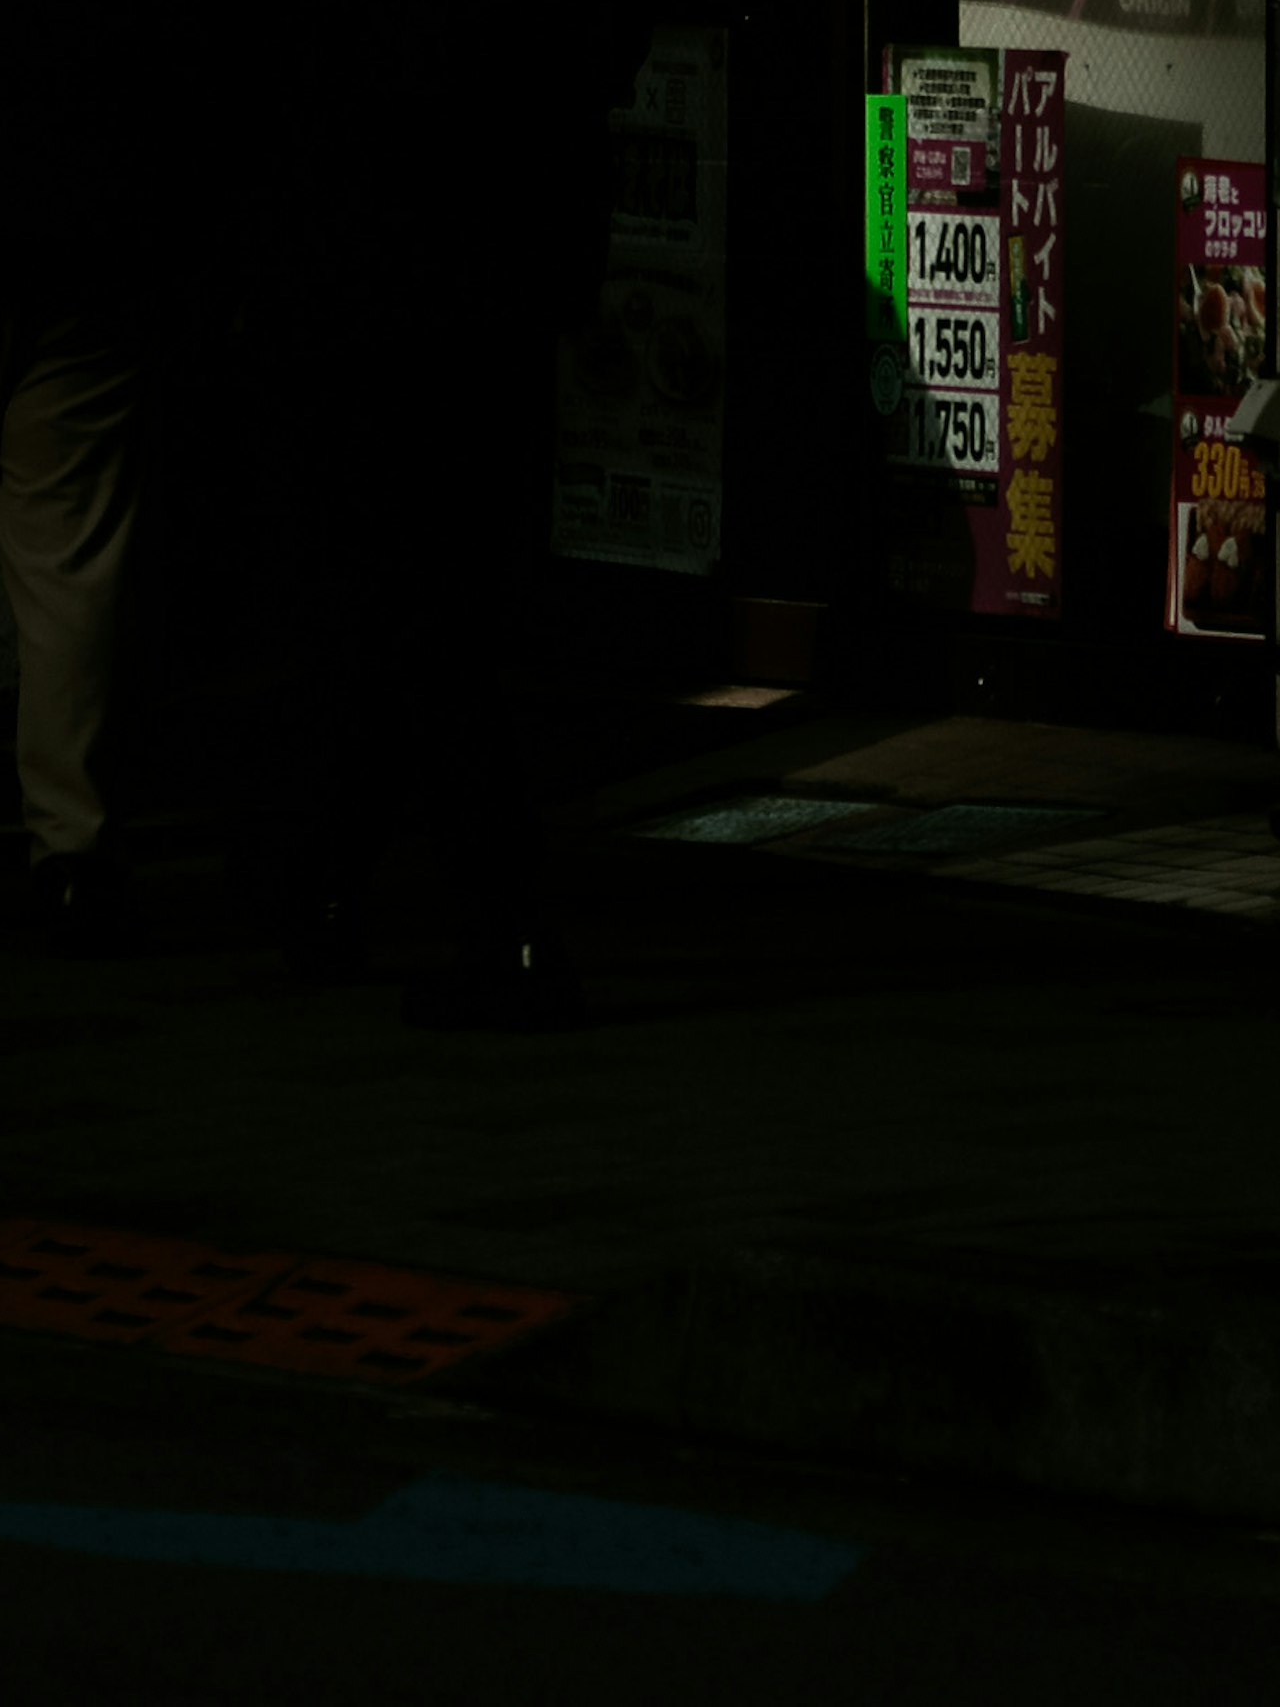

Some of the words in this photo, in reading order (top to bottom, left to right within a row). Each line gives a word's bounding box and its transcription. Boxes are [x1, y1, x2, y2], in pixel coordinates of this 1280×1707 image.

[1007, 65, 1033, 228] パート
[1032, 69, 1058, 335] アルバイト
[1006, 351, 1058, 580] 募集
